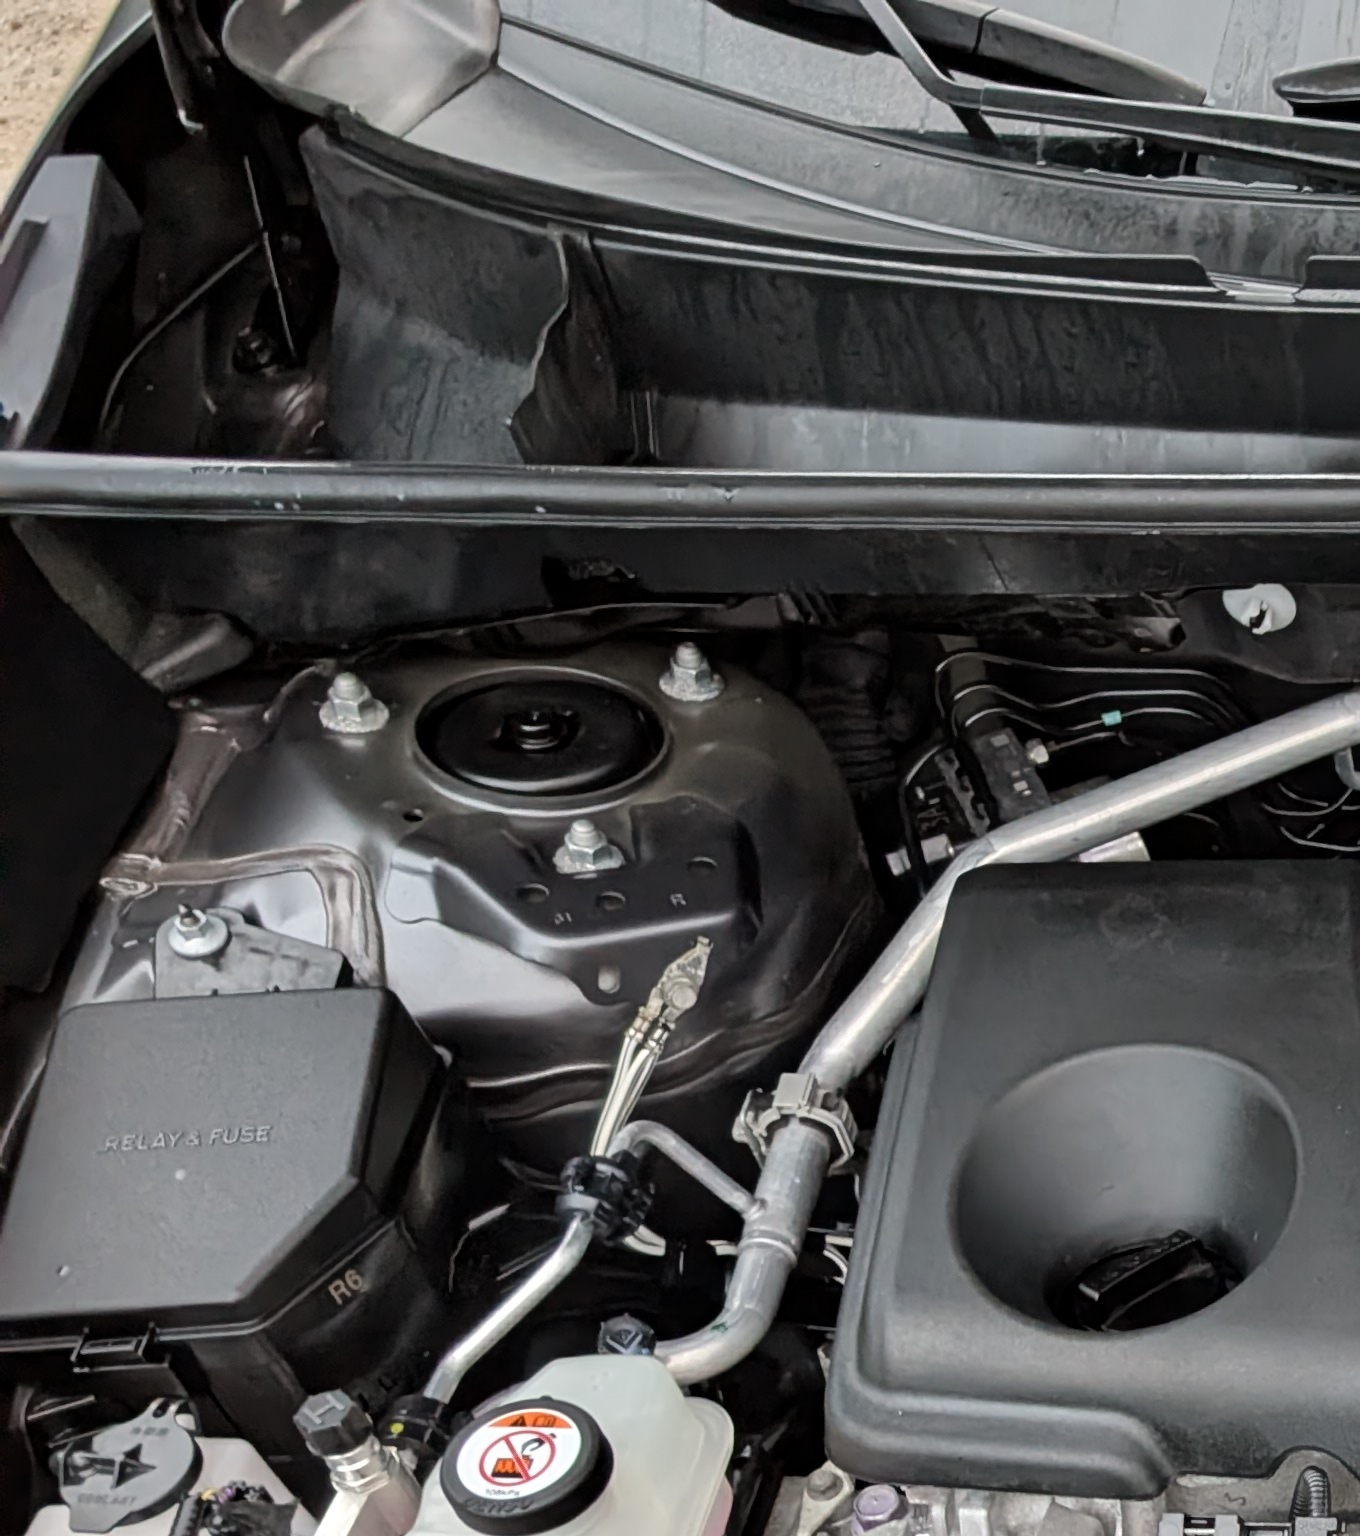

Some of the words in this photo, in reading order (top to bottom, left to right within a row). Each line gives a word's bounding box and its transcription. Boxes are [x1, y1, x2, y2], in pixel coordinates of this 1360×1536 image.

[103, 1130, 184, 1152] RELAY
[209, 1124, 274, 1146] FUSE
[327, 1268, 363, 1306] R6
